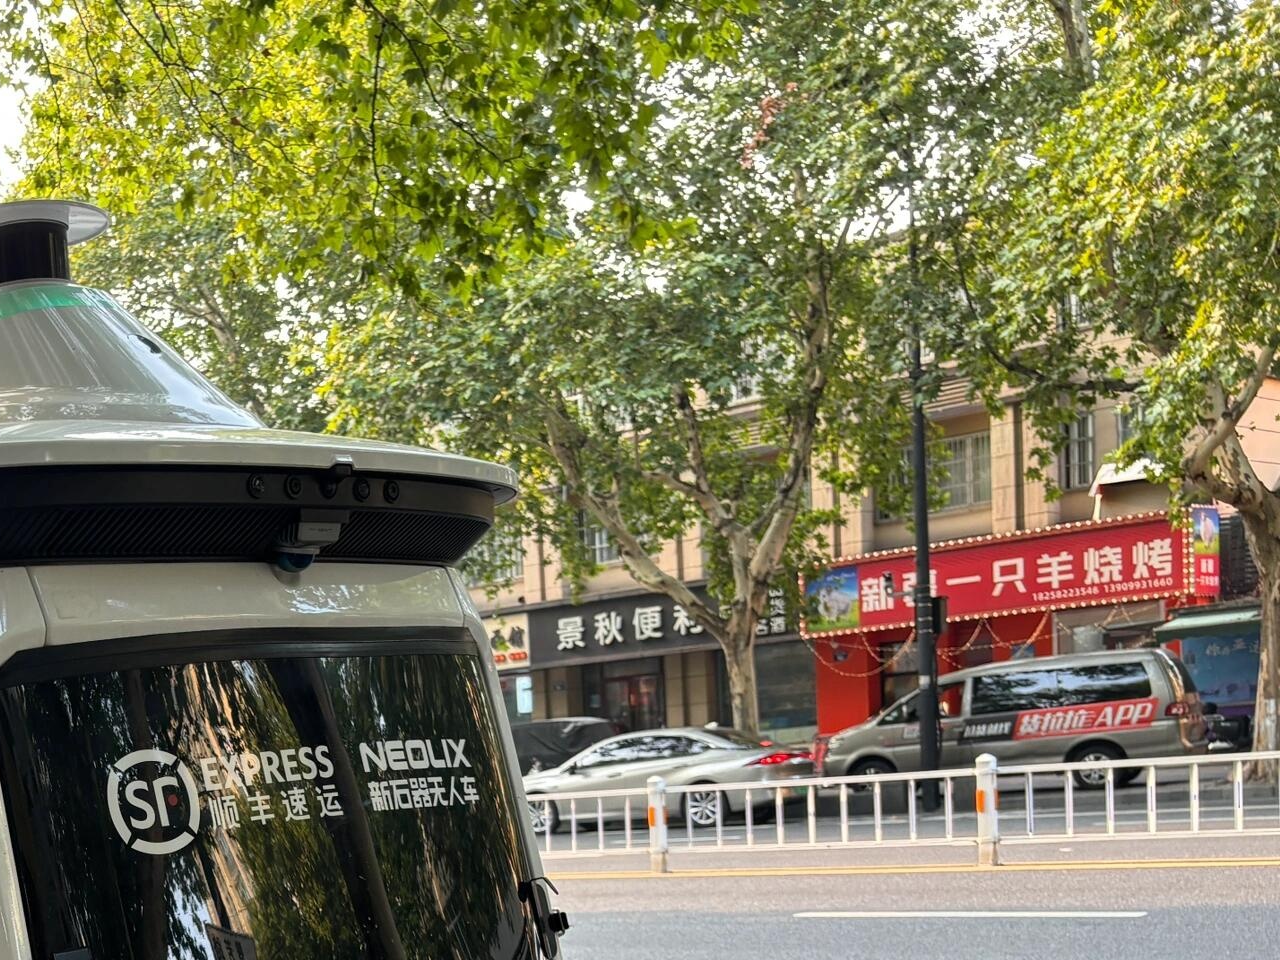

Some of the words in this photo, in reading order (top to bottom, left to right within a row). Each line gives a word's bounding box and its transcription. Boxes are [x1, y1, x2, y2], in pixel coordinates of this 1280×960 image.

[199, 744, 335, 793] EXPRESS
[358, 738, 473, 773] NEOLIX
[207, 784, 345, 830] 顺丰速运
[368, 775, 480, 812] 新石器无人车
